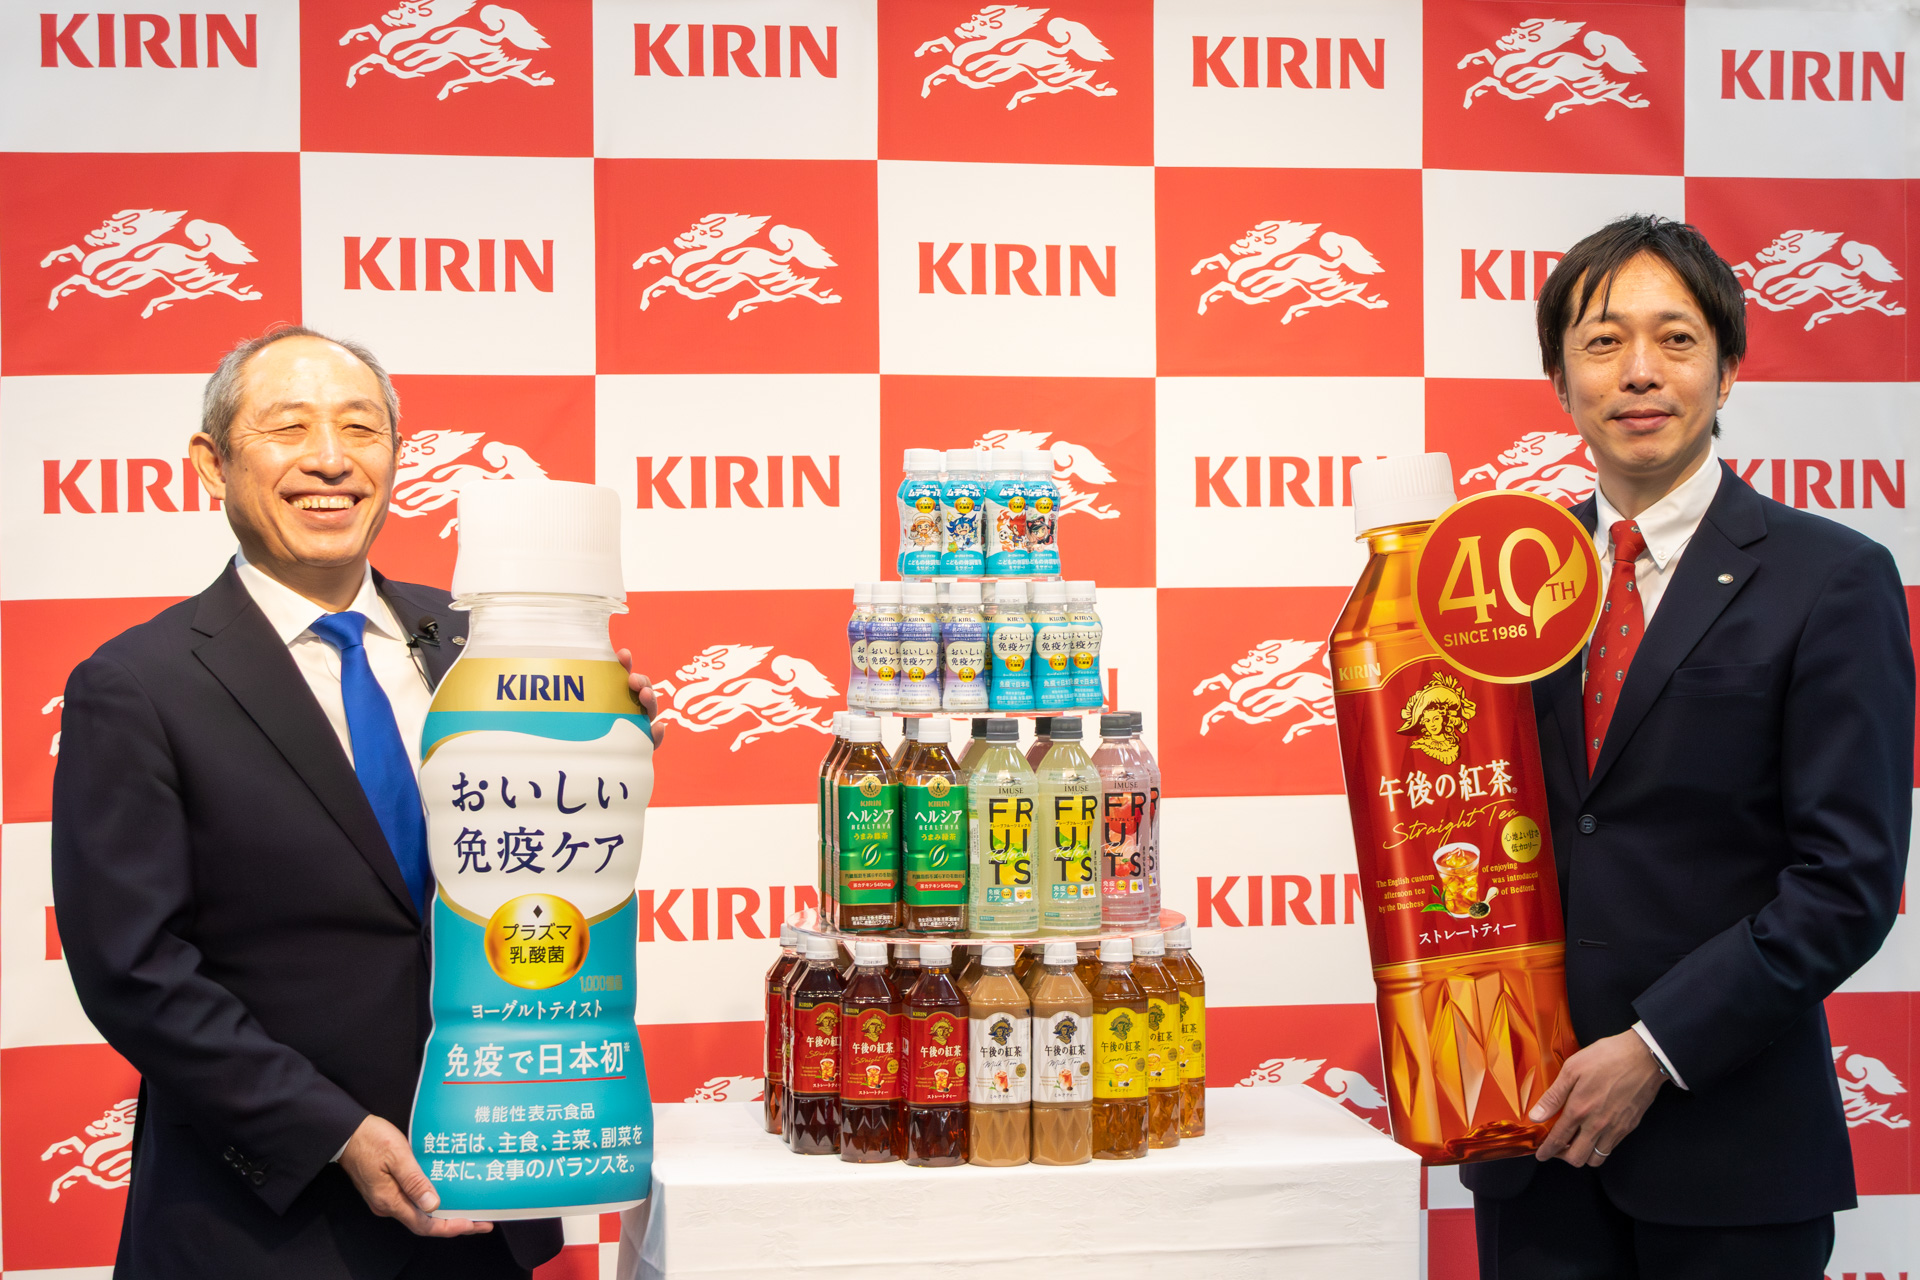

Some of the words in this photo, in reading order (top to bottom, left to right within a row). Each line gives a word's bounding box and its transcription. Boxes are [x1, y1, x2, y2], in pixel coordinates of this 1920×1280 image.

[40, 14, 258, 69] KIRIN
[633, 23, 838, 78] KIRIN
[1192, 35, 1386, 90] KIRIN
[1721, 49, 1906, 102] KIRIN
[343, 236, 555, 293] KIRIN
[918, 241, 1117, 298] KIRIN
[42, 457, 222, 514] KIRI
[636, 455, 841, 511] KIRIN
[1545, 580, 1577, 602] TH
[998, 642, 1031, 652] 免疫ケア
[999, 633, 1031, 641] おいしい
[1443, 629, 1490, 648] SINCE
[1492, 624, 1528, 641] 1986
[902, 648, 934, 656] おいしい
[902, 657, 934, 666] 免疫ケア
[952, 648, 982, 656] おいしい
[952, 658, 982, 666] 免疫ケア
[1338, 662, 1381, 682] KIRIN
[496, 674, 585, 702] KIRIN
[452, 770, 629, 815] おいしい
[846, 808, 895, 823] ヘルシア
[989, 797, 1034, 823] FR
[1055, 795, 1098, 821] FR
[1104, 792, 1147, 817] FR
[914, 809, 963, 824] ヘルシア
[1382, 808, 1479, 850] Straight
[1477, 798, 1519, 826] Tea
[853, 832, 889, 841] うまみ緑茶
[921, 833, 957, 842] うまみ緑茶
[453, 826, 625, 875] 免疫ケア
[989, 859, 1031, 885] TS
[1054, 856, 1093, 882] TS
[1376, 880, 1388, 888] The
[1388, 876, 1410, 887] English
[1411, 874, 1435, 882] custom
[1482, 864, 1490, 873] of
[1490, 862, 1518, 873] enjoying
[1384, 889, 1413, 900] afternoon
[1414, 887, 1426, 895] tea
[1492, 876, 1506, 884] was
[1507, 871, 1539, 882] introduced
[1378, 905, 1386, 914] by
[1386, 903, 1396, 912] the
[1396, 900, 1424, 910] Duchess
[1501, 887, 1509, 896] of
[503, 922, 573, 942] プラズマ
[1418, 922, 1517, 945] ストレートティー
[510, 946, 565, 965] 乳酸菌
[471, 999, 603, 1022] ヨーグルトテイスト
[806, 1036, 841, 1048] 午後の紅
[852, 1042, 894, 1055] 午後の紅茶
[920, 1045, 962, 1058] 午後の紅茶
[980, 1046, 1022, 1058] 午後の紅茶
[1044, 1044, 1086, 1057] 午後の紅茶
[1100, 1040, 1141, 1053] 午後の紅茶
[474, 1102, 596, 1124] 機能性表示食品
[423, 1124, 643, 1154] 食生活は、主食、主菜、副菜を
[430, 1153, 636, 1183] 基本に、食事のバランスを。
